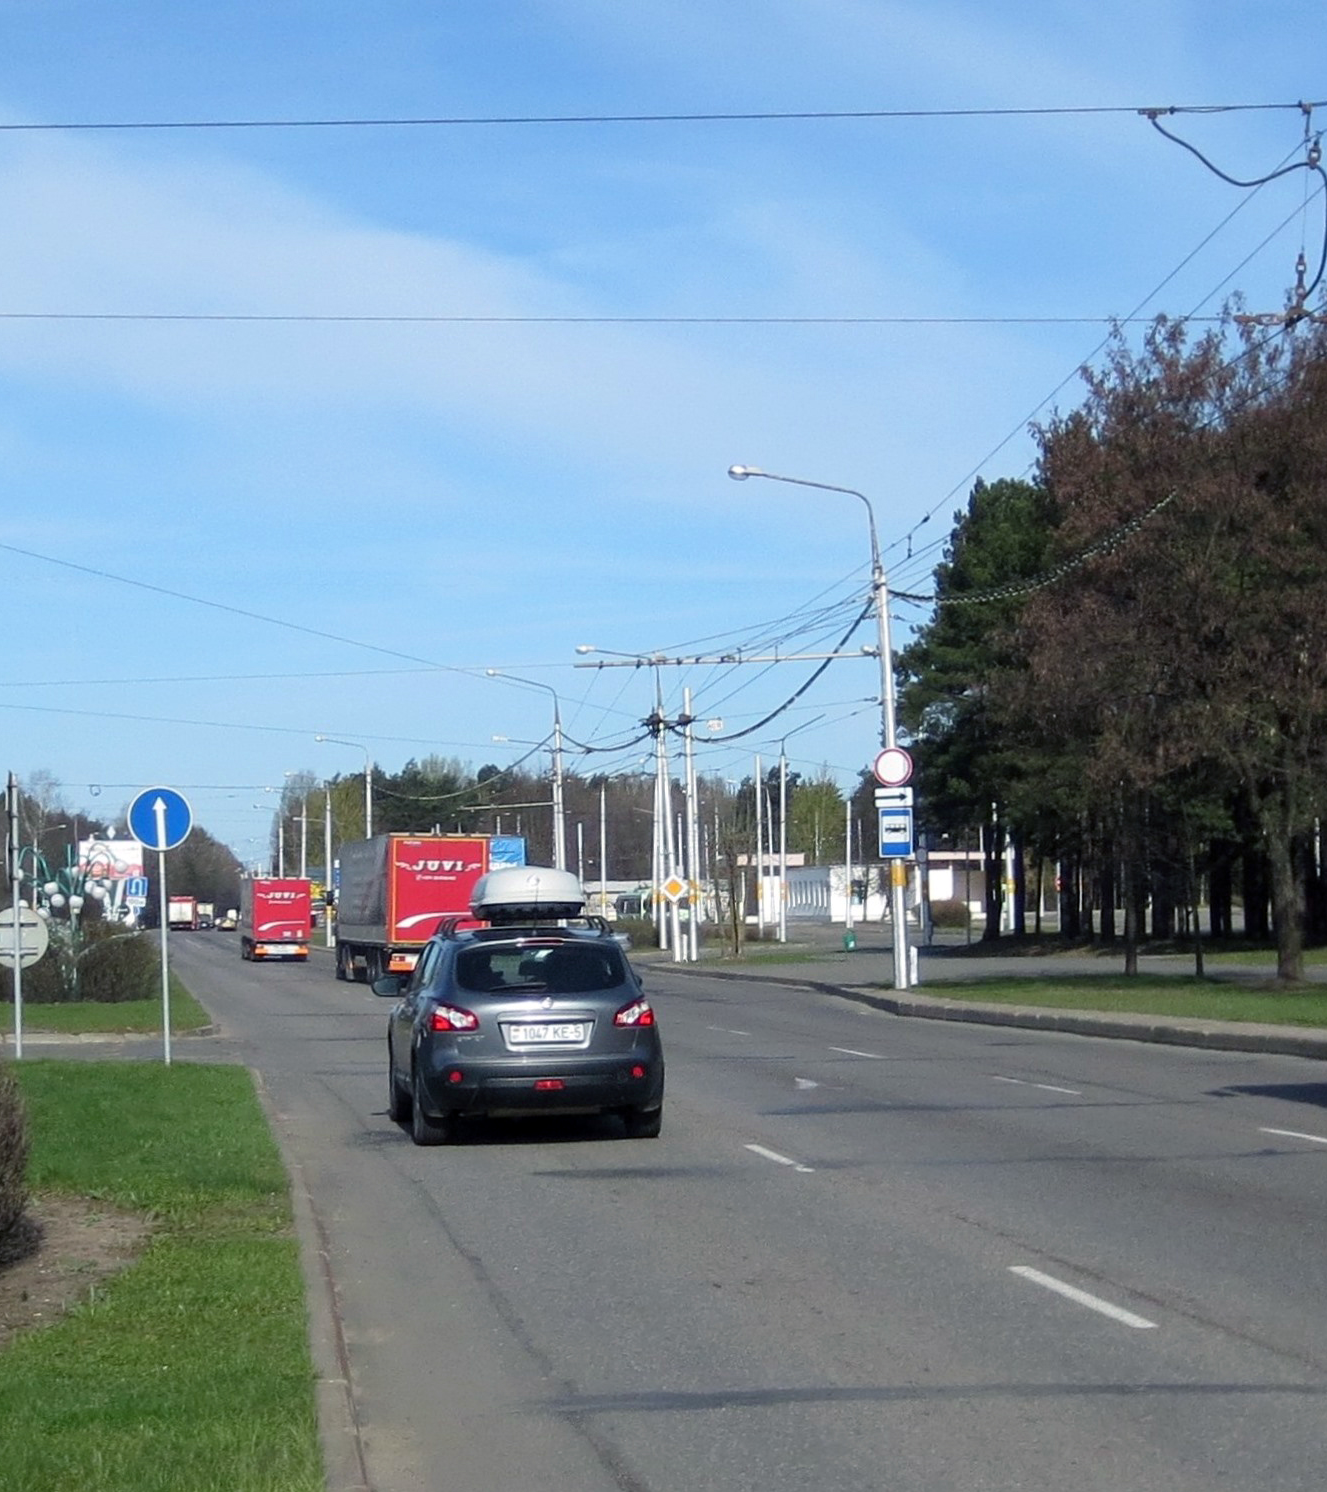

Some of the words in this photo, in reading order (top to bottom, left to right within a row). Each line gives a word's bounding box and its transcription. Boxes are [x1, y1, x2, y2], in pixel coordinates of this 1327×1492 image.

[411, 860, 464, 872] JUVI
[523, 1027, 549, 1040] 1047
[553, 1026, 582, 1039] KE-5
